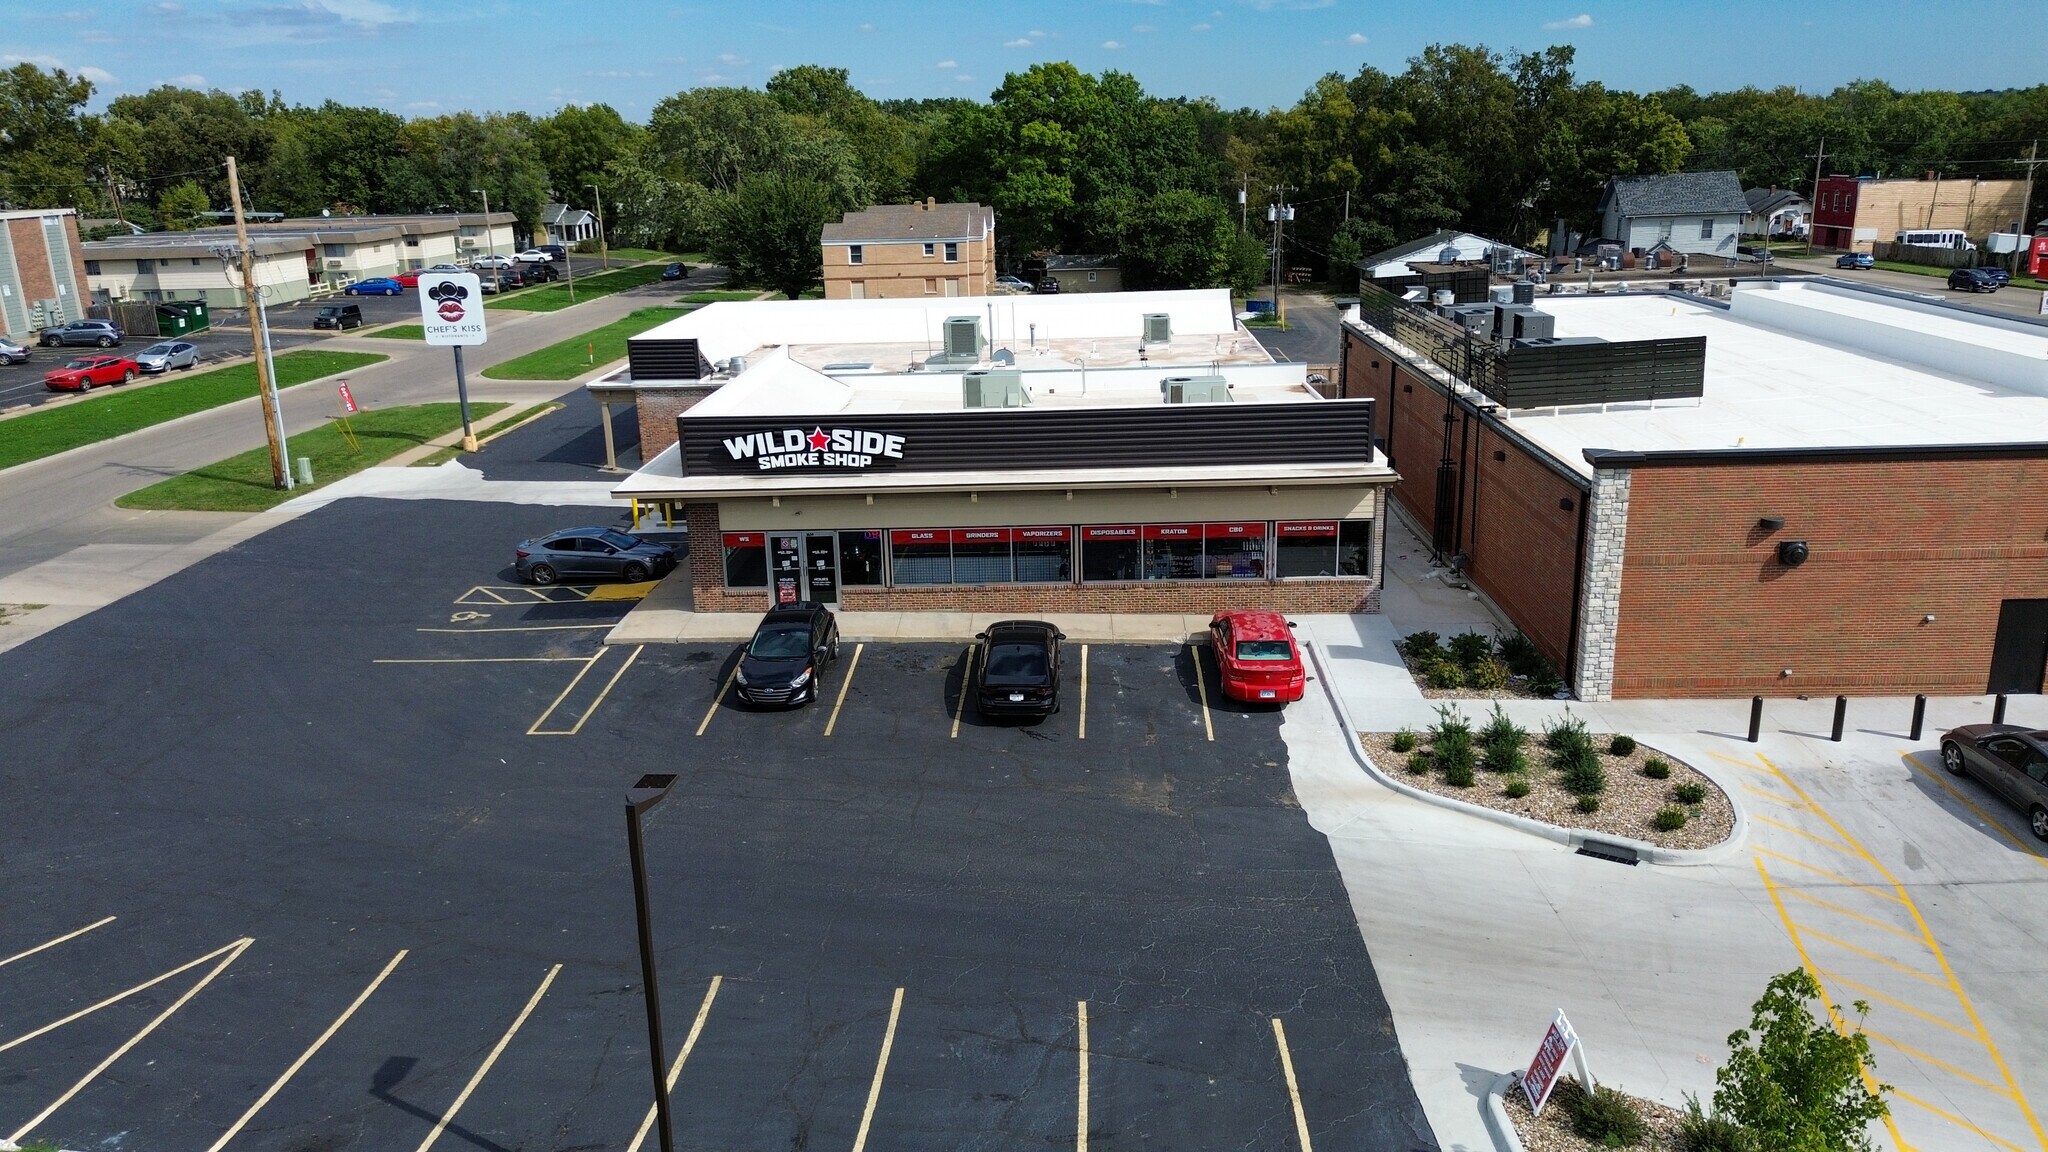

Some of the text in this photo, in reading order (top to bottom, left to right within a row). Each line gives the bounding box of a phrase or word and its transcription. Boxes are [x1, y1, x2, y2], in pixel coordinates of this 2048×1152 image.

[427, 325, 457, 333] CHEF'S
[722, 429, 906, 460] WILD SIDE
[758, 453, 872, 470] SMOKE SHOP
[1090, 528, 1136, 536] DISPOSABLES
